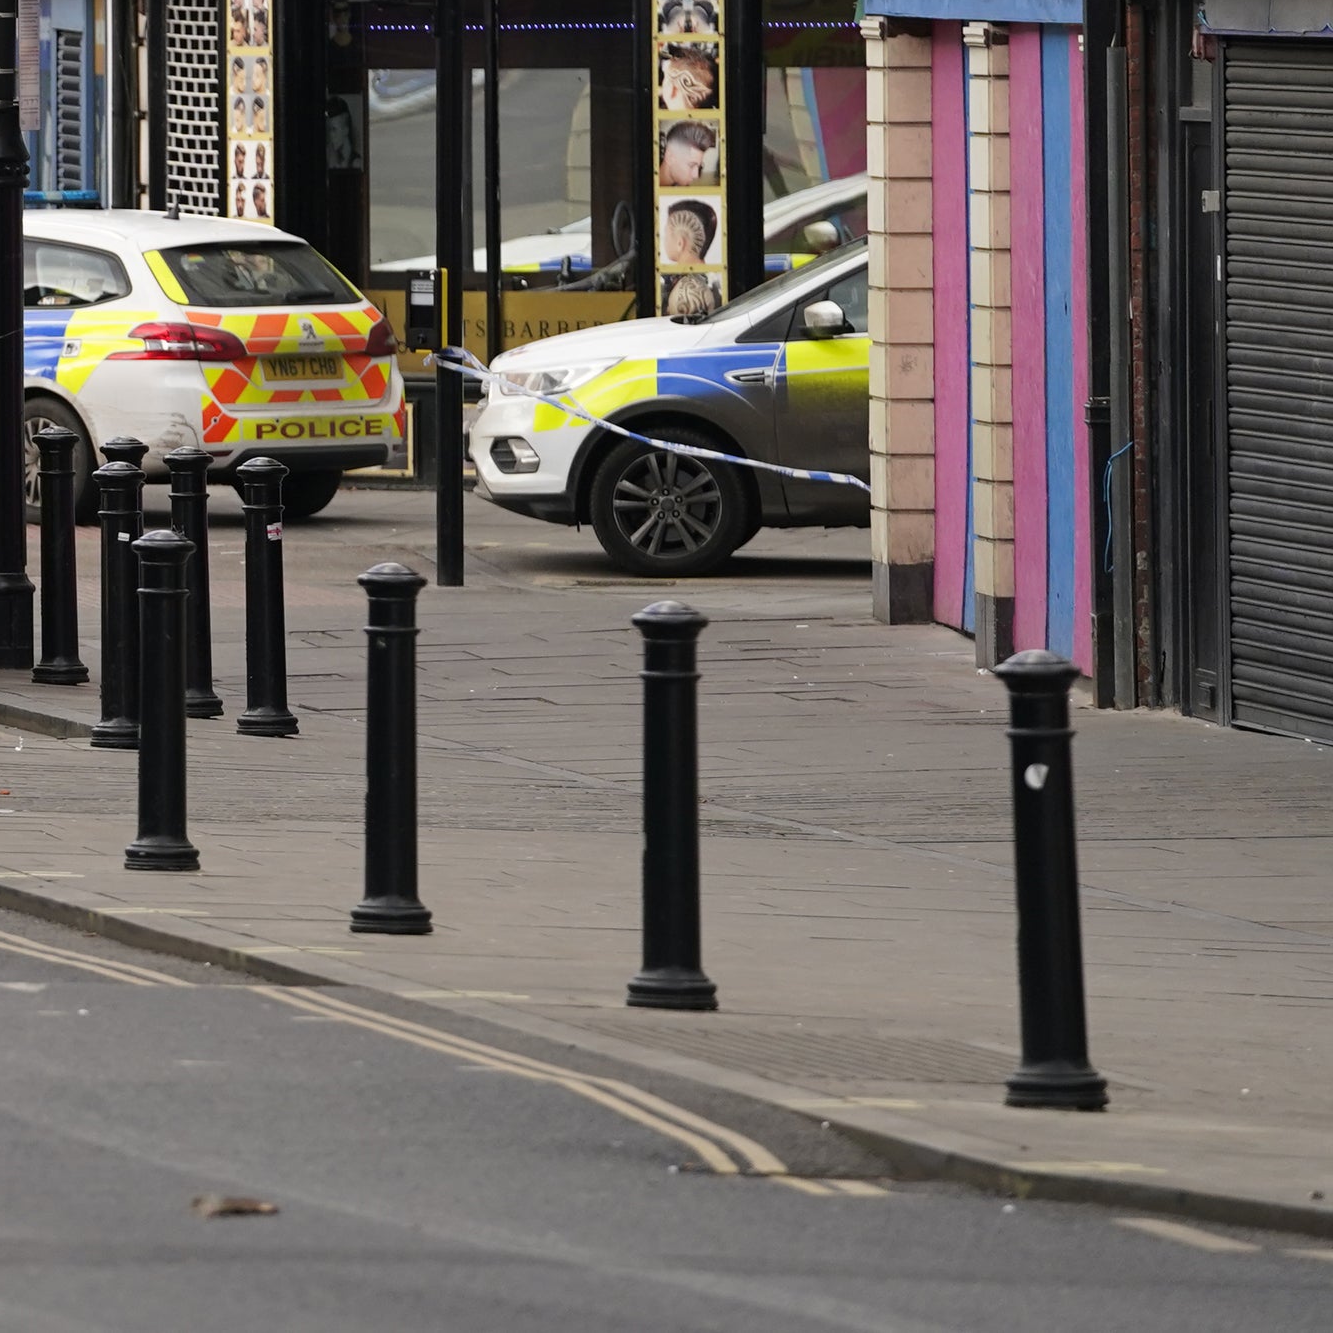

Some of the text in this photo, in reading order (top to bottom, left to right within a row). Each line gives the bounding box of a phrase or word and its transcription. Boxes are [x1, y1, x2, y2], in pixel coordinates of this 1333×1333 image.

[504, 319, 604, 339] BARBE
[268, 358, 304, 377] YN67
[255, 419, 383, 440] POLICE
